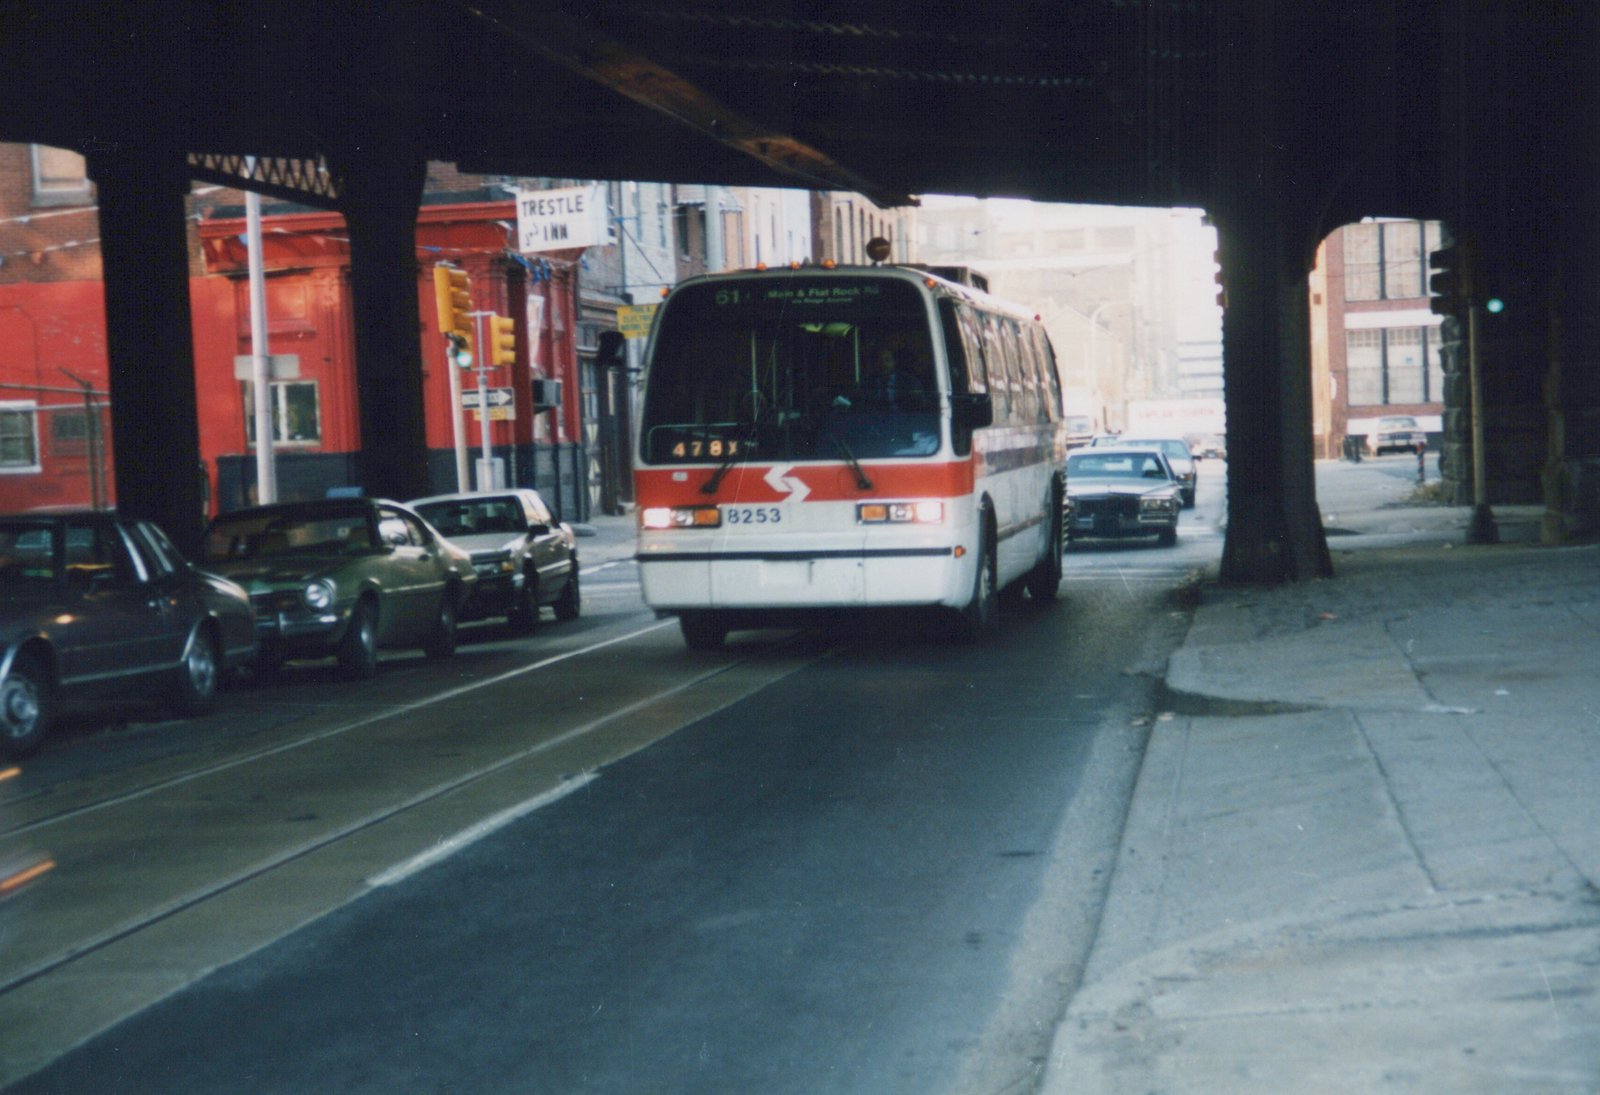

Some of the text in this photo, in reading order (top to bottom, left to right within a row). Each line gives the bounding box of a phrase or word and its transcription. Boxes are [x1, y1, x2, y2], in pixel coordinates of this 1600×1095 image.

[522, 194, 584, 217] TRESTLE
[543, 223, 568, 241] INN
[715, 289, 739, 304] 61
[809, 288, 829, 297] Flat
[832, 287, 859, 296] Rock
[728, 508, 782, 524] 8253
